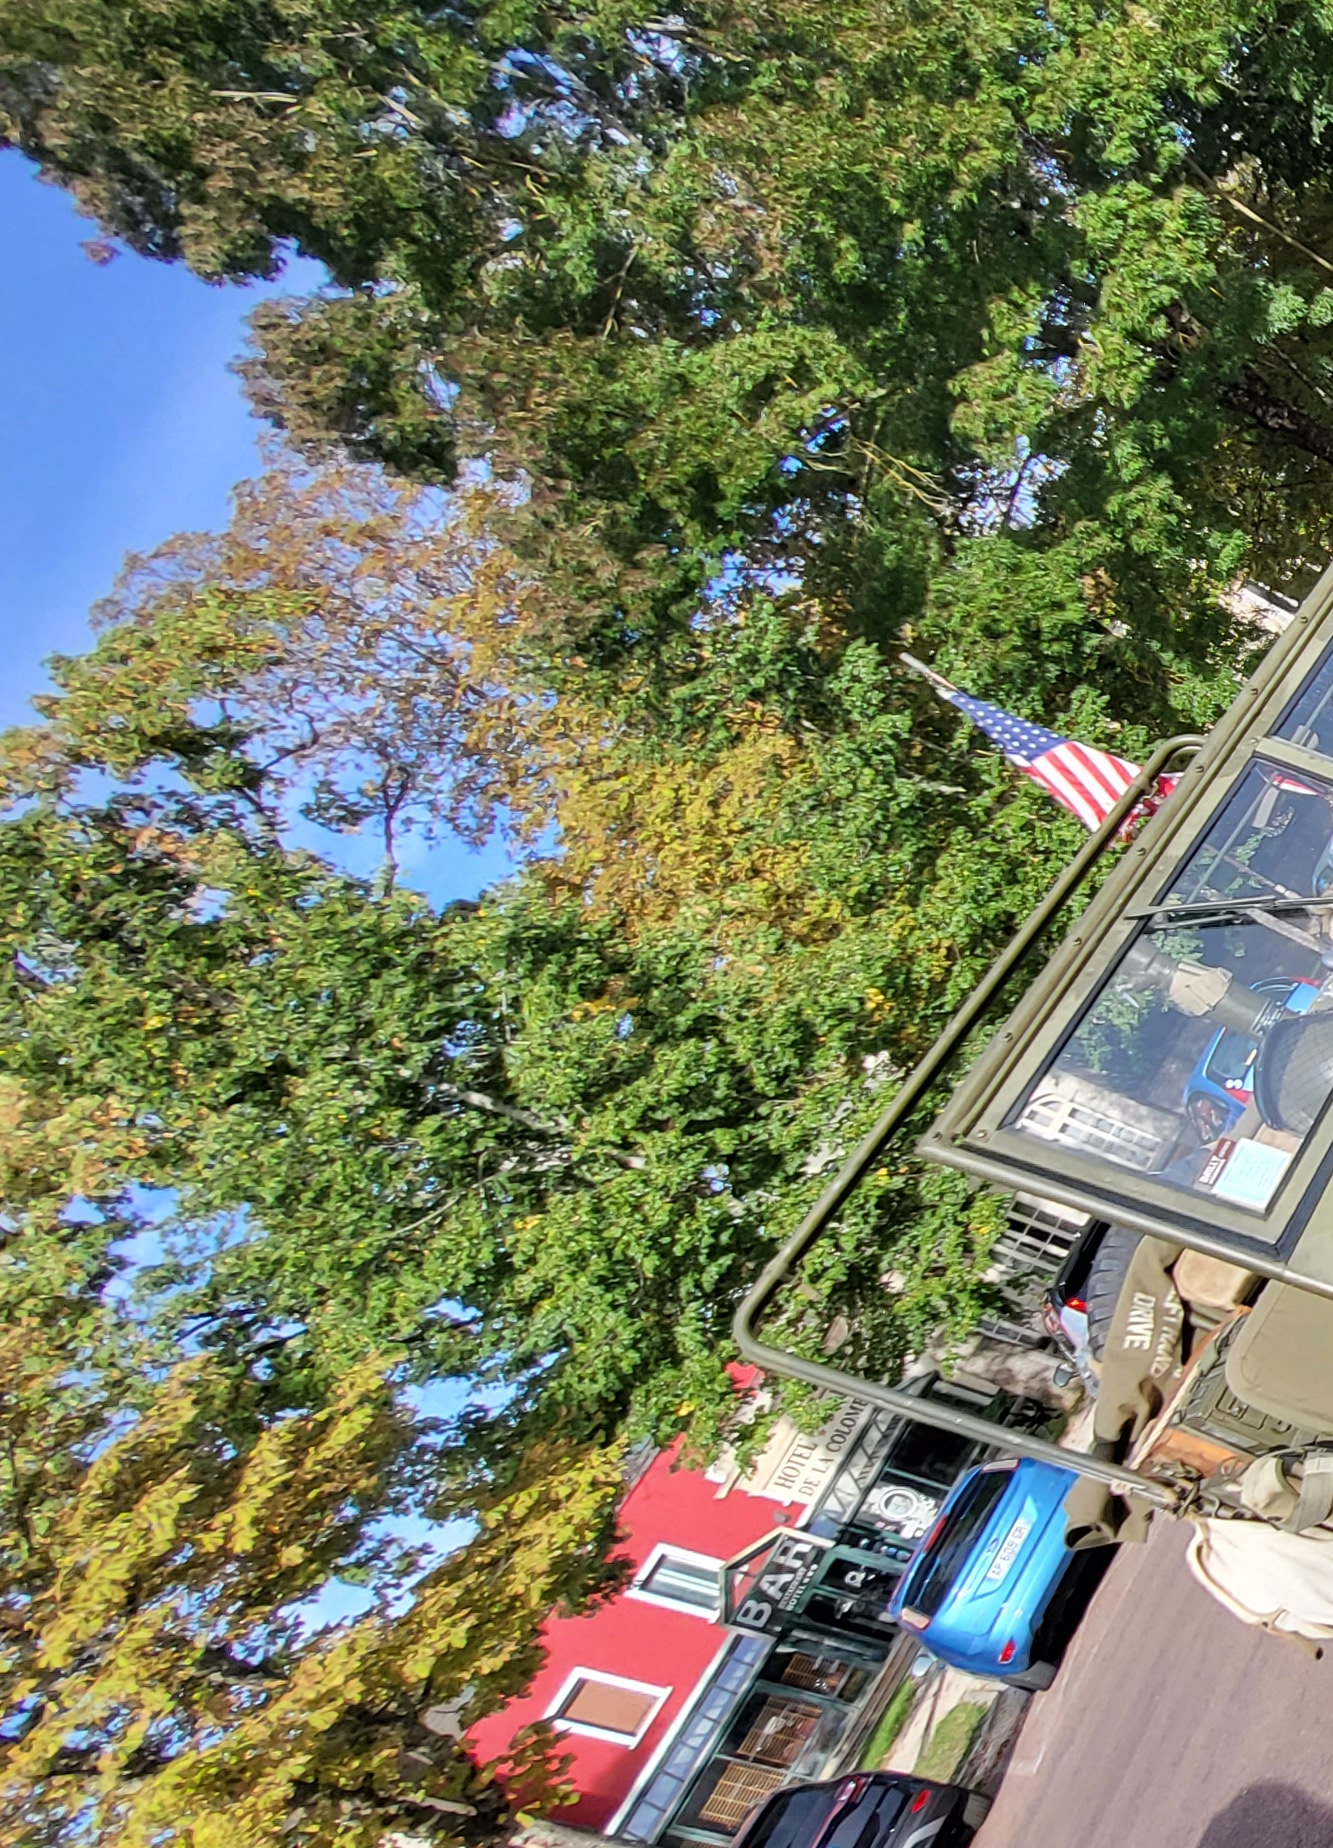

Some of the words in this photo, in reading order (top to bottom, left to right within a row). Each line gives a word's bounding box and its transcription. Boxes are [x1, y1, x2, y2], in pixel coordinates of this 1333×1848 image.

[1123, 1292, 1156, 1351] DRIVE
[774, 1437, 817, 1489] HOTEL
[799, 1475, 820, 1495] DE
[812, 1456, 833, 1473] LA
[734, 1535, 813, 1629] BAR
